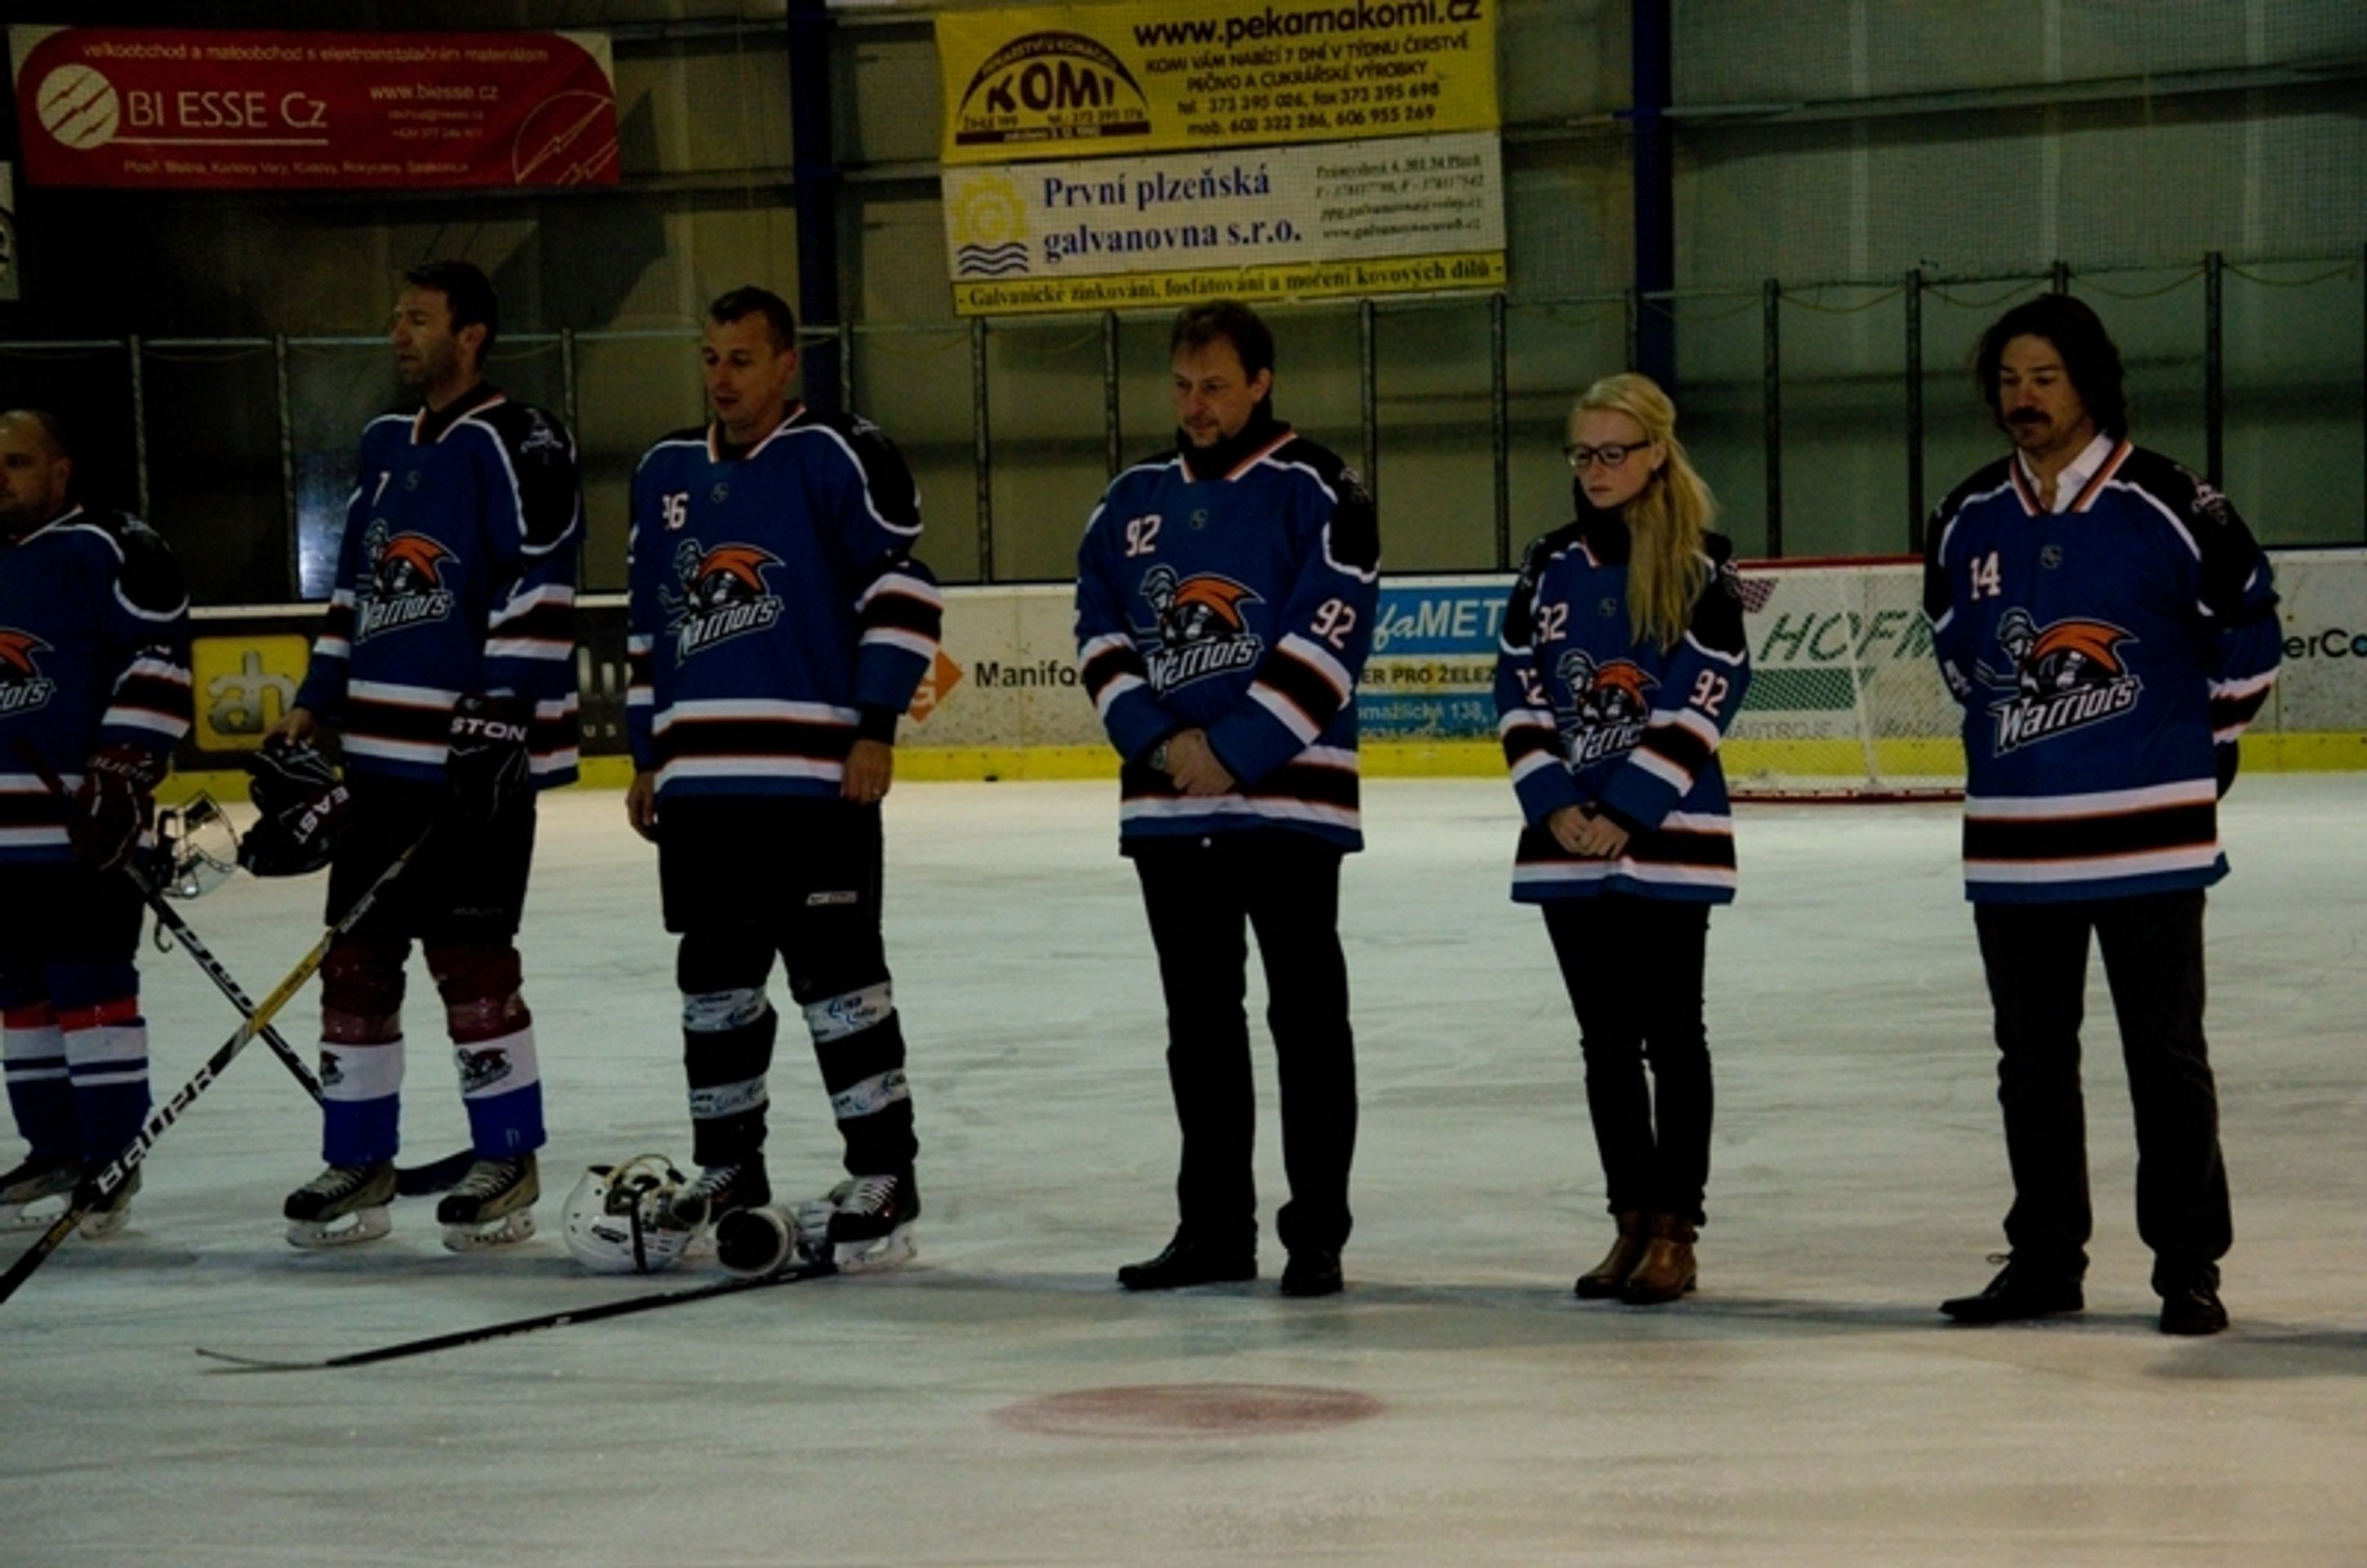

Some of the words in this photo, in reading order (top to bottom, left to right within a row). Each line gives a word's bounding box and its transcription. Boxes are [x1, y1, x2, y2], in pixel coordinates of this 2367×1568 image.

[127, 89, 163, 127] BI
[176, 90, 269, 128] ESSE
[279, 90, 328, 129] Cz
[986, 59, 1115, 114] KOMI
[1043, 172, 1126, 207] První
[1136, 163, 1271, 212] plzeňská
[1043, 222, 1219, 265] galvanovna
[1227, 219, 1302, 246] s.r.o.
[1123, 514, 1163, 559] 92
[1968, 549, 2003, 601] 14
[676, 597, 781, 666] Warriors
[1310, 596, 1357, 650] 92
[1145, 635, 1263, 697] Warriors
[1391, 666, 1433, 686] PRO
[1689, 668, 1728, 719] 92
[1990, 676, 2142, 757] Warriors
